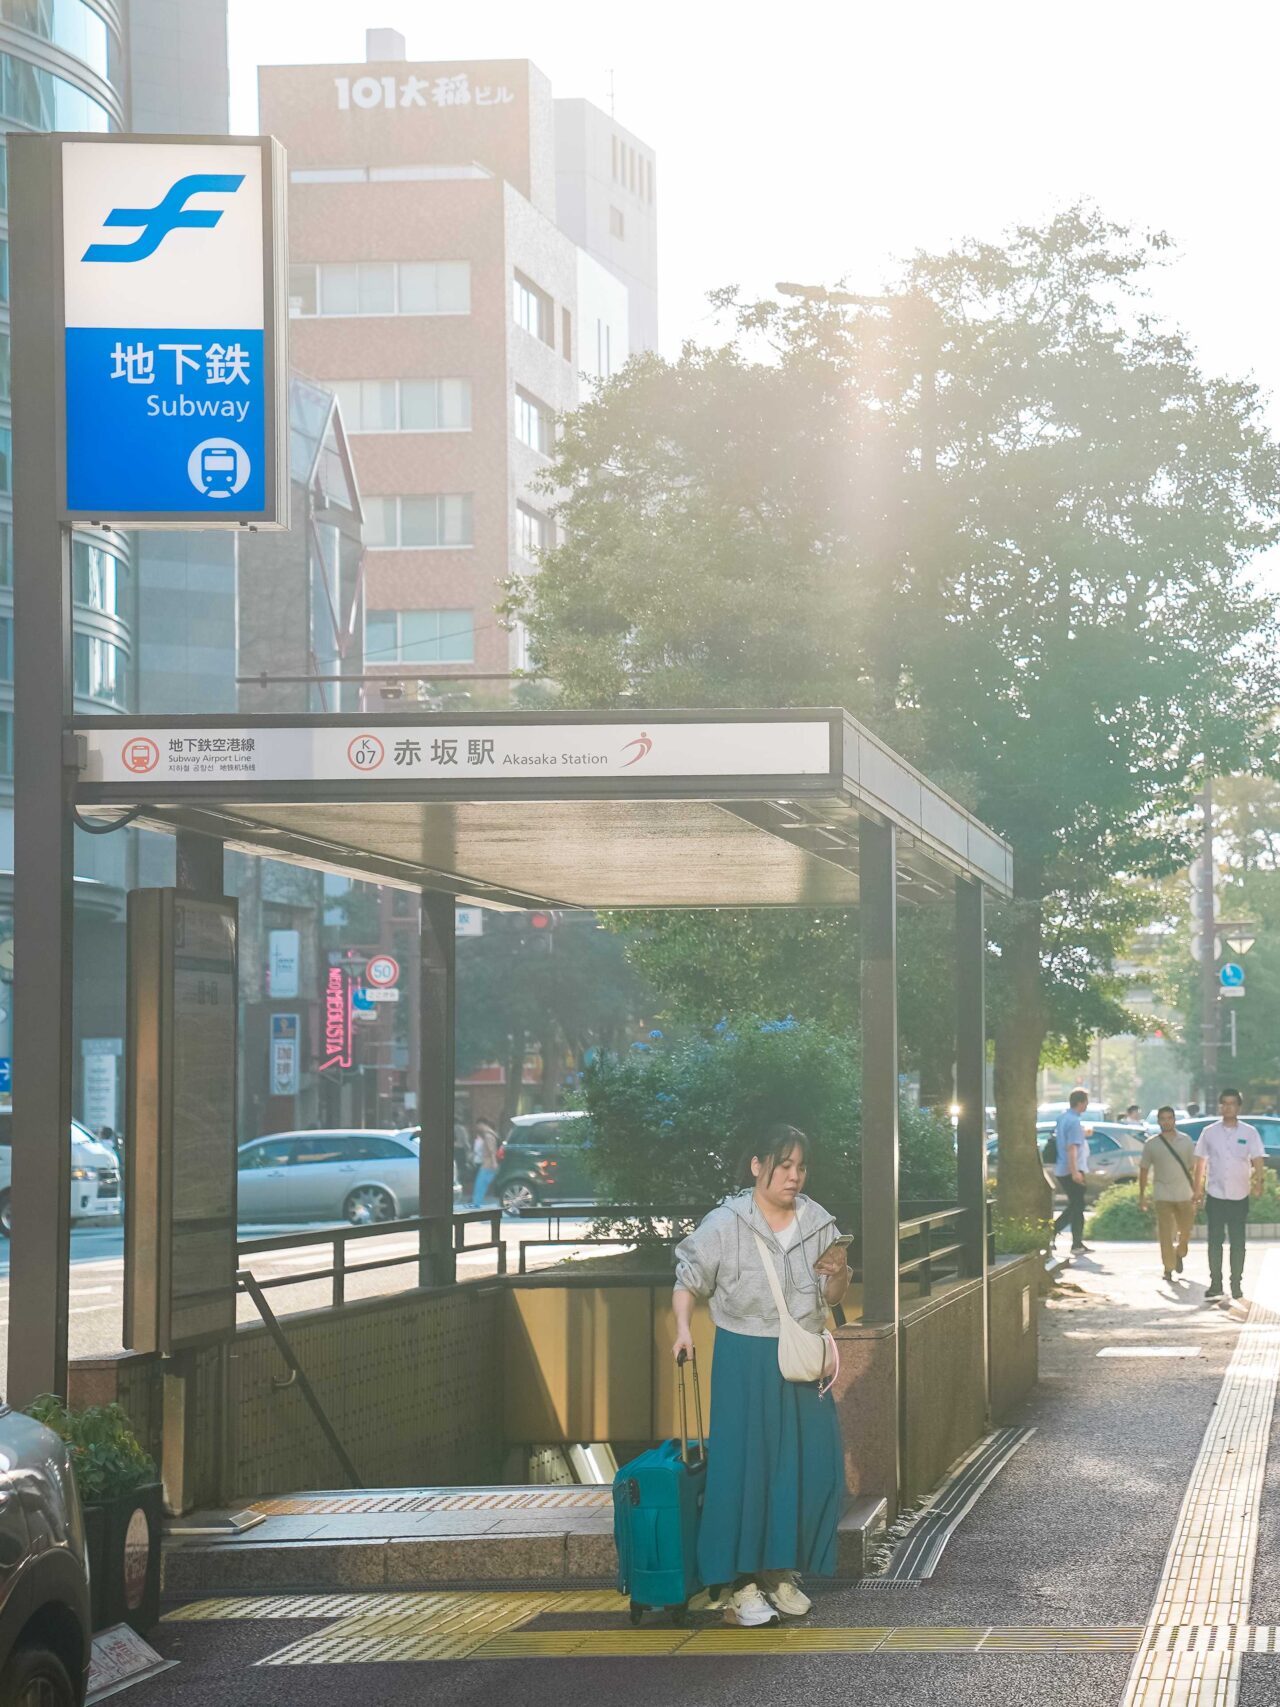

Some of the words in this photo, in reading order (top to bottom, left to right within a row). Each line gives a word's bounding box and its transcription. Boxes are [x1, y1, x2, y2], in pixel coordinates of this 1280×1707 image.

[110, 343, 250, 386] 地下鉄
[146, 394, 250, 422] Subway
[168, 738, 256, 752] 地下鉄空港線
[361, 740, 371, 749] K
[168, 754, 201, 764] Subway
[202, 754, 233, 764] Airport
[234, 754, 252, 762] Line
[355, 751, 376, 765] 07
[393, 738, 495, 766] 赤坂駅
[502, 752, 557, 765] Akasaka
[561, 752, 608, 765] Station
[373, 965, 392, 979] 50
